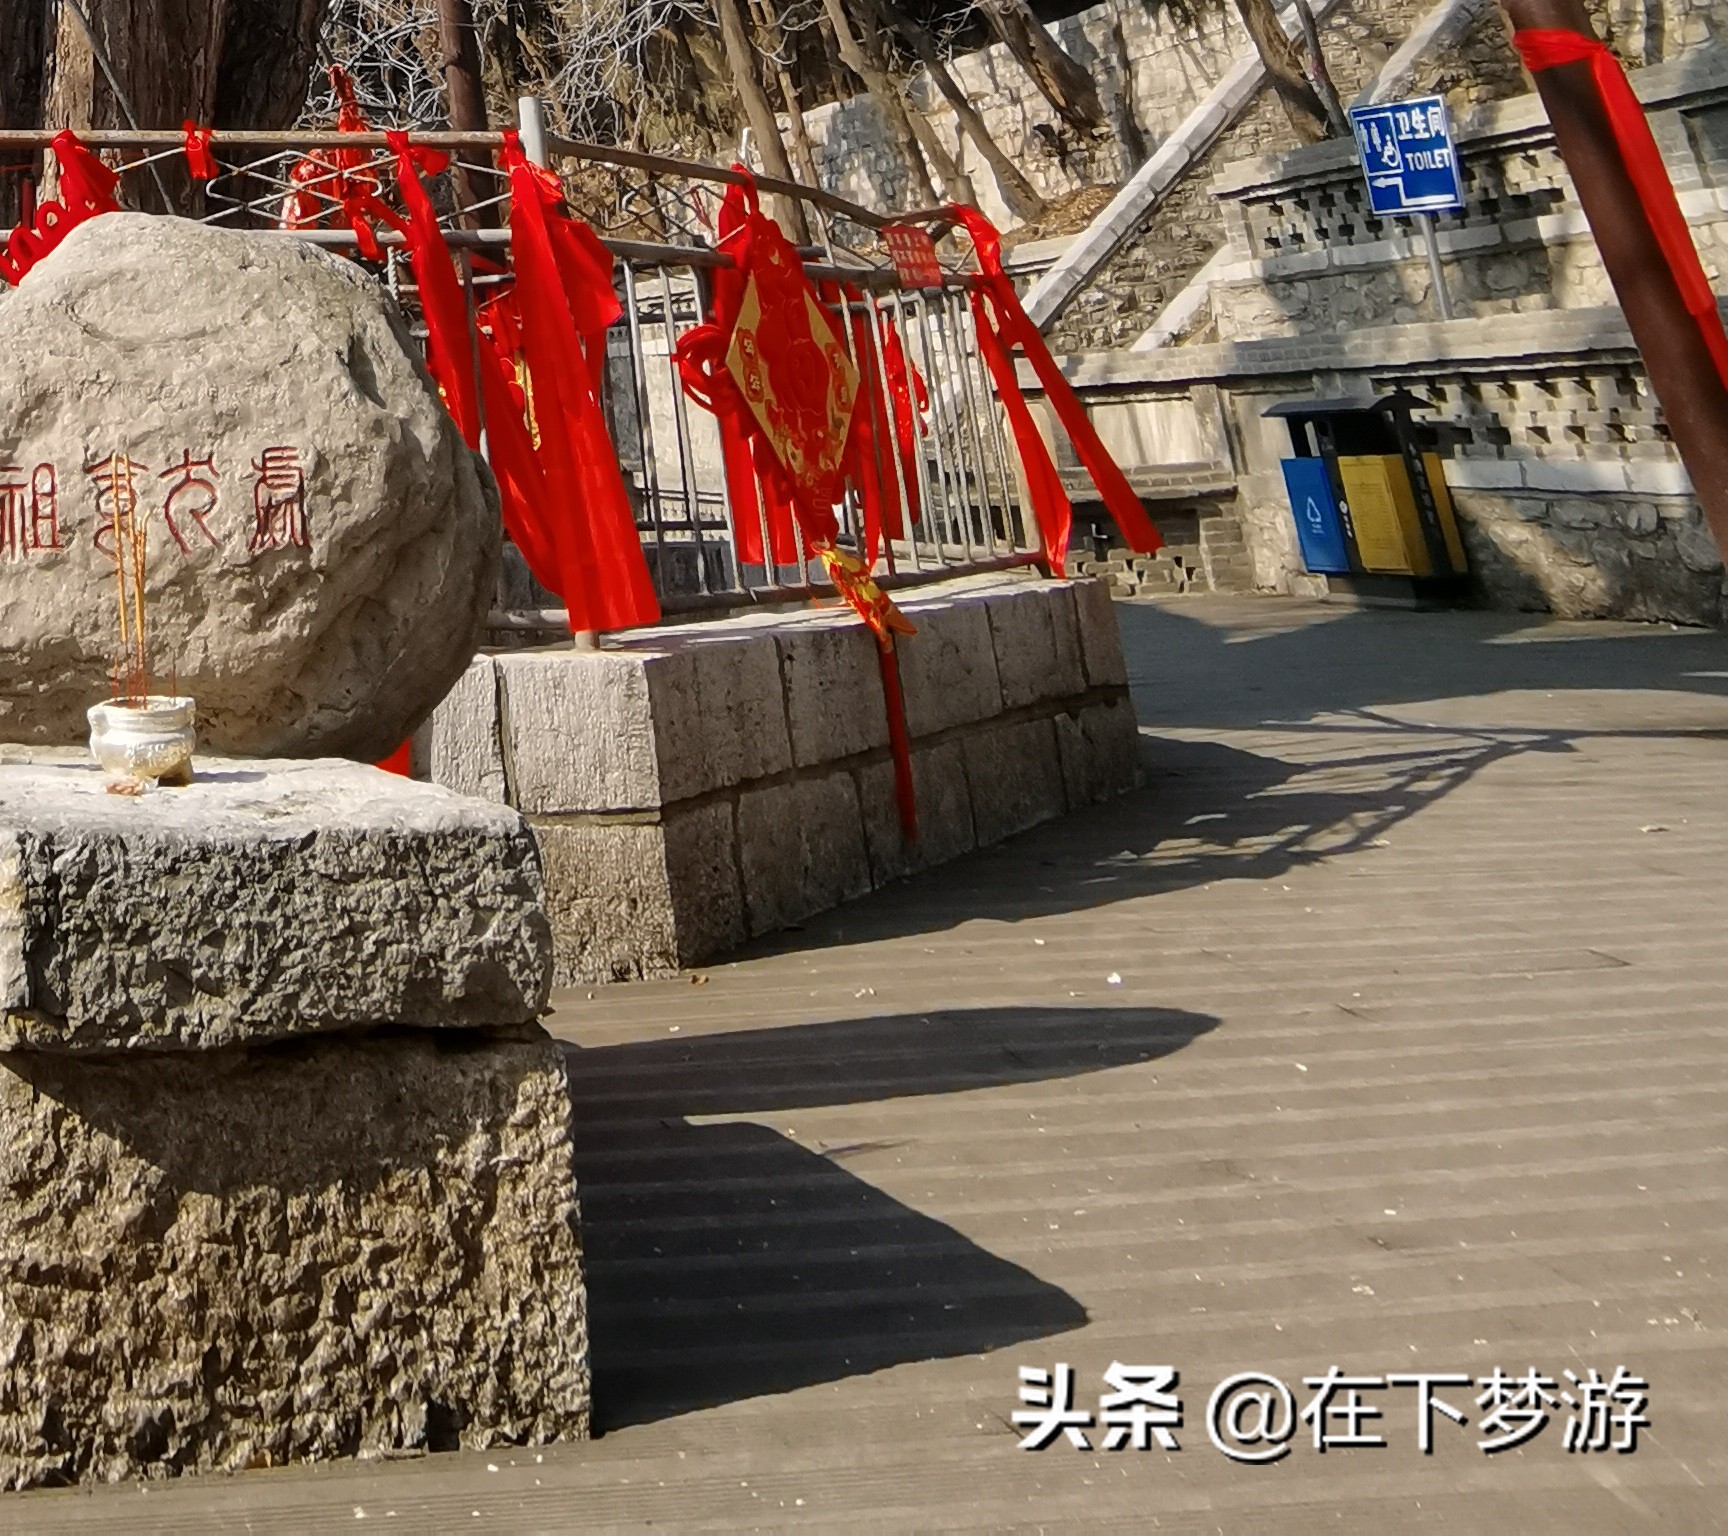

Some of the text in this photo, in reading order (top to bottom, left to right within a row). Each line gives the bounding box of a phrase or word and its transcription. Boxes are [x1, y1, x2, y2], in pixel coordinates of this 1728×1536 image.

[1395, 106, 1446, 140] 卫生间
[1405, 148, 1450, 171] TOILET
